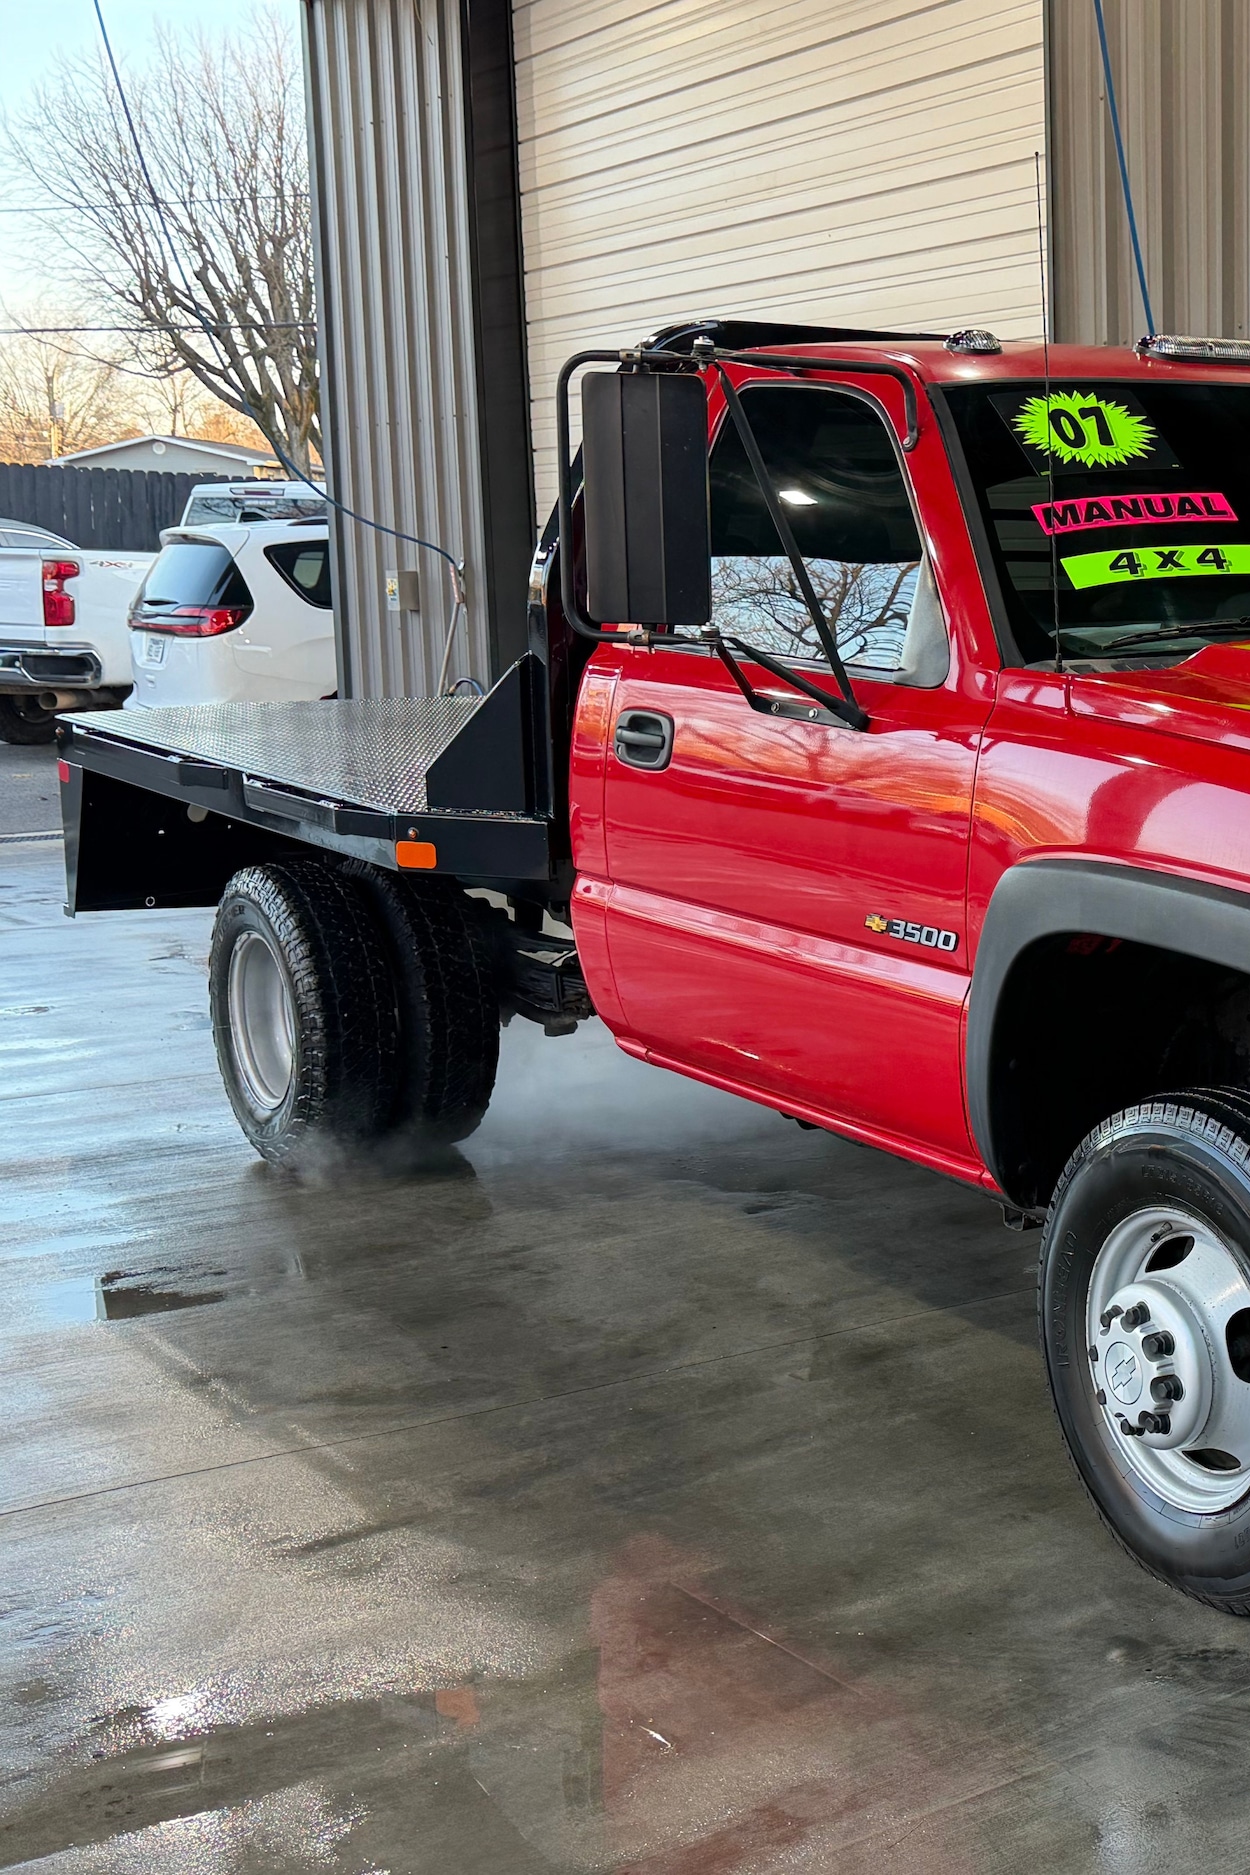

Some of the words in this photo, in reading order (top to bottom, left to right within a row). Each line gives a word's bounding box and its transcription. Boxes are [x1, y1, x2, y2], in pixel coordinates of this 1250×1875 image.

[1049, 406, 1115, 450] 07
[1042, 495, 1230, 529] MANUAL
[888, 918, 958, 952] 3500
[1052, 1230, 1078, 1367] IRONHEAD
